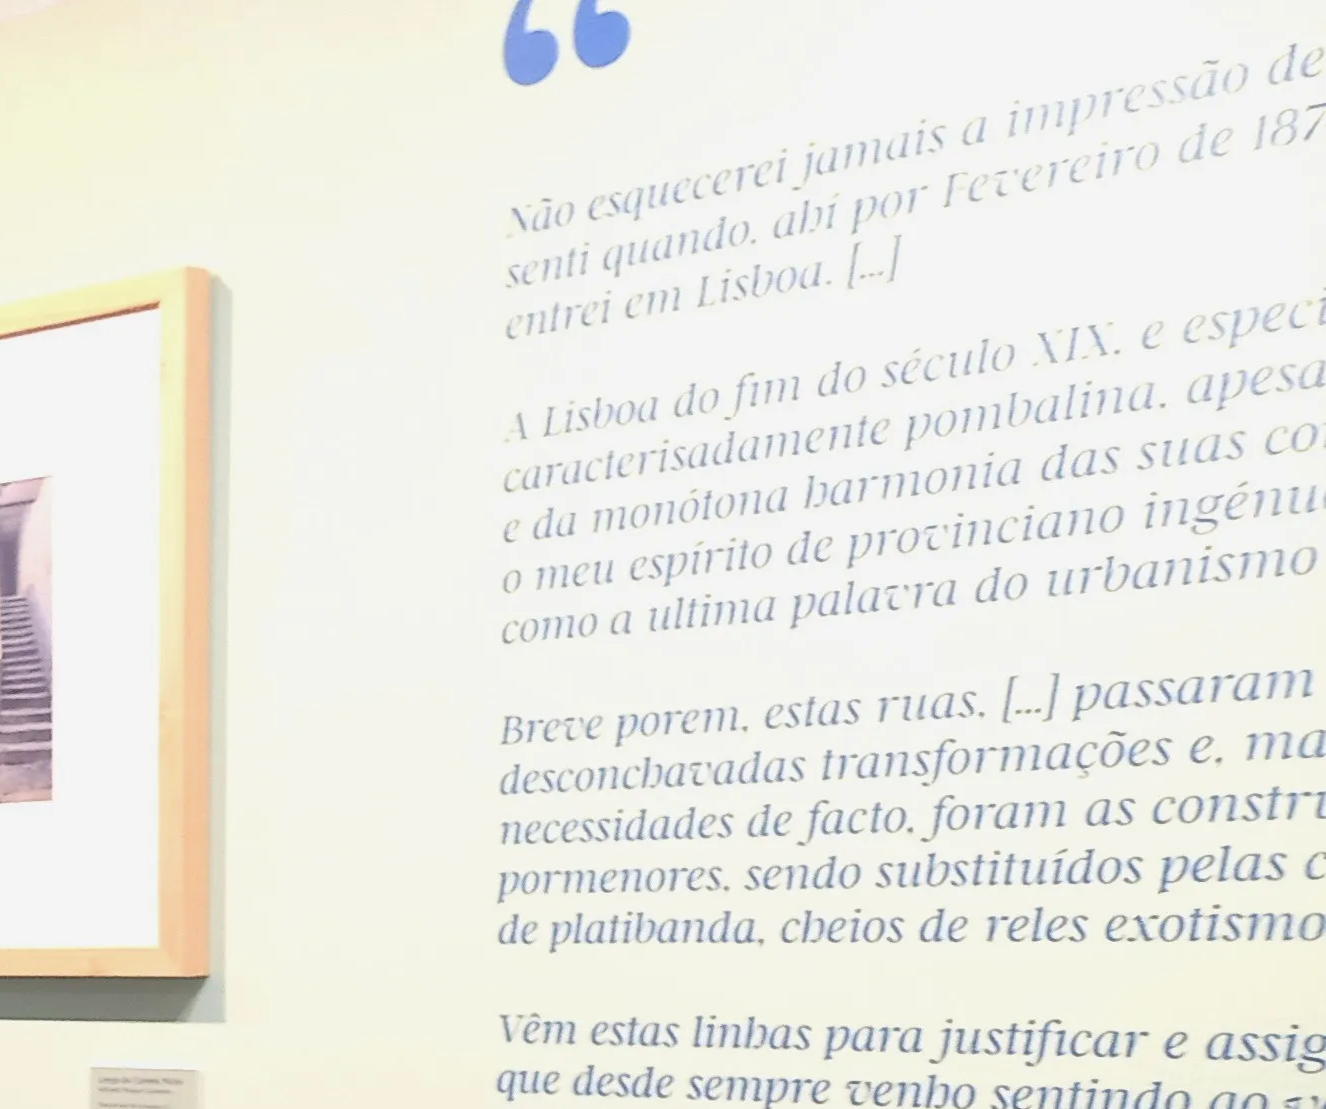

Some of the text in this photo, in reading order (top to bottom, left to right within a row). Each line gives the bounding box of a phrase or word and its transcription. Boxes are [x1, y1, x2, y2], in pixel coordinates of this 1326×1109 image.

[506, 42, 1326, 238] Não esquecerei jamais a impressão de
[505, 242, 590, 289] senti
[851, 185, 929, 235] por
[942, 142, 1160, 208] Fevereiro
[1178, 122, 1234, 164] de
[505, 290, 611, 340] entrei
[624, 286, 681, 320] em
[504, 412, 529, 443] A
[543, 396, 659, 437] Lisboa
[673, 382, 720, 418] do
[724, 372, 800, 421] fim
[817, 360, 867, 397] do
[881, 338, 1016, 389] século
[1141, 321, 1164, 350] e
[503, 415, 890, 494] caracterisadamente
[1186, 359, 1326, 412] apesa
[502, 422, 1326, 544] e da monótona harmonia das suas co
[502, 481, 1326, 594] o meu espírito de provinciano ingénu
[501, 545, 1318, 645] como a ultima palavra do urbanismo
[500, 715, 604, 745] Breve
[764, 696, 862, 730] estas
[1072, 668, 1314, 722] passaram
[822, 730, 1173, 787] transformações
[501, 806, 734, 845] necessidades
[747, 804, 793, 838] de
[920, 794, 1066, 843] foram
[1085, 798, 1136, 827] as
[744, 855, 862, 891] sendo
[875, 848, 1144, 889] substituídos
[1157, 845, 1288, 894] pelas
[497, 913, 538, 945] de
[780, 908, 905, 944] cheios
[918, 908, 969, 943] de
[986, 906, 1089, 943] reles
[499, 1012, 576, 1045] Vêm
[590, 1017, 680, 1048] estas
[692, 1015, 812, 1051] linhas
[823, 1025, 923, 1061] para
[929, 1018, 1150, 1067] justificar
[1163, 1031, 1189, 1060] e
[496, 1069, 560, 1102] que
[572, 1064, 675, 1099] desde
[845, 1074, 977, 1109] venho
